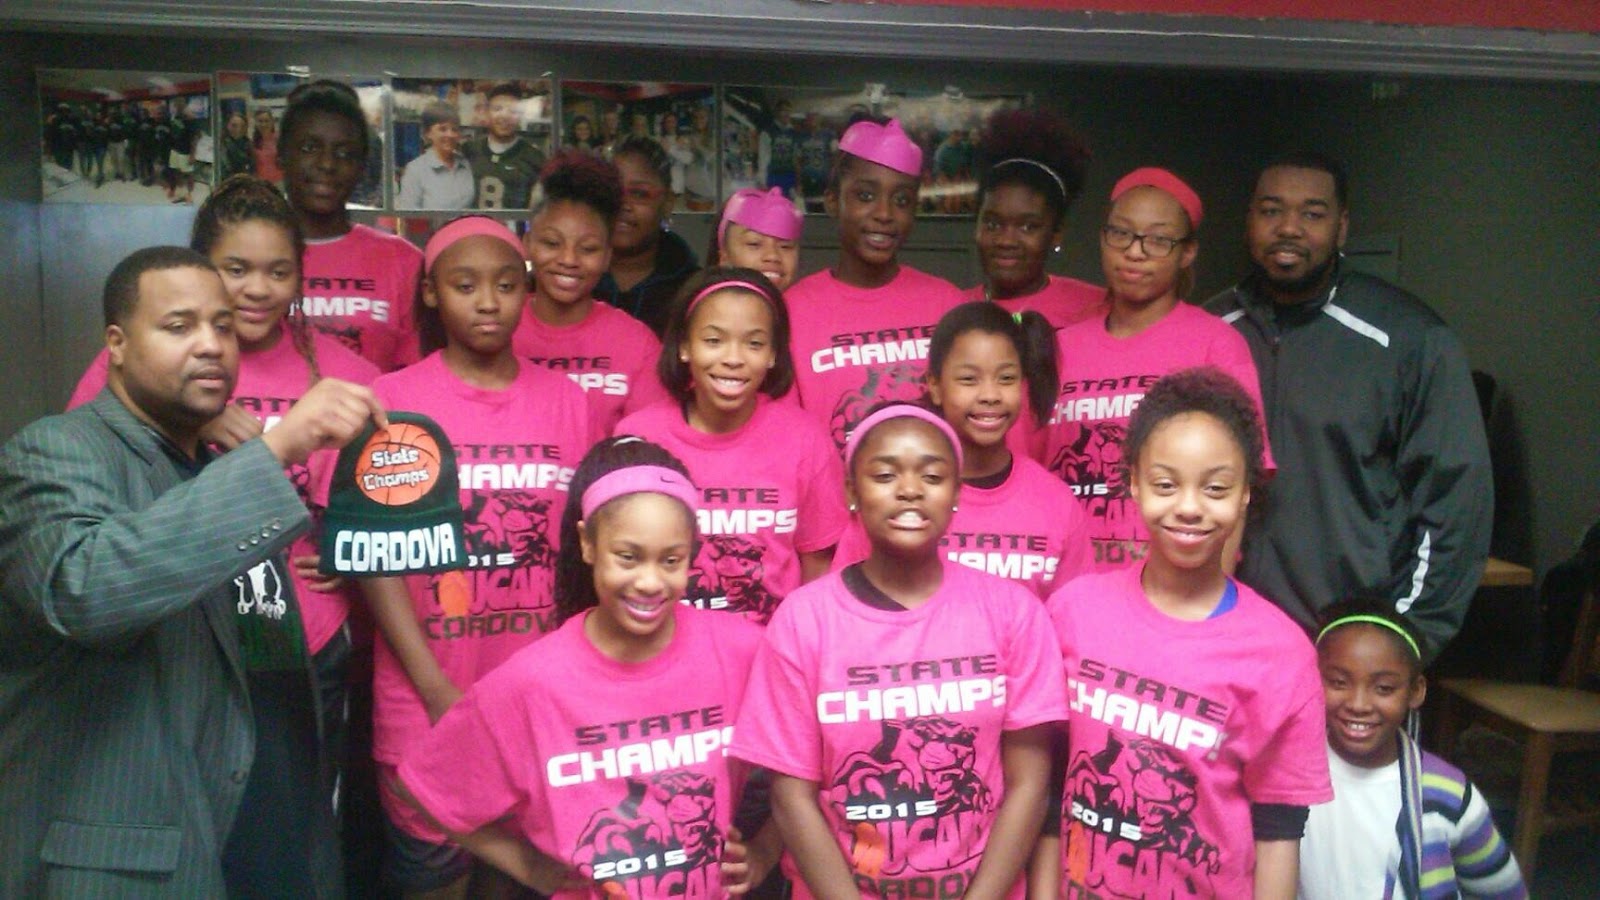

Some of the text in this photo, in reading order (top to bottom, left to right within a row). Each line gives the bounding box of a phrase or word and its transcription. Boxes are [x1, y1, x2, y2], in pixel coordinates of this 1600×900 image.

[307, 277, 376, 291] ATE
[363, 469, 430, 490] Champs
[457, 463, 576, 491] HAMPS
[334, 522, 457, 572] CORDOVA
[424, 611, 556, 640] CORDOV
[847, 654, 998, 687] STATE
[1077, 658, 1229, 726] STATE
[574, 704, 724, 747] STATE
[845, 800, 938, 821] 2015
[1071, 801, 1142, 842] 2015
[592, 848, 688, 881] 2015
